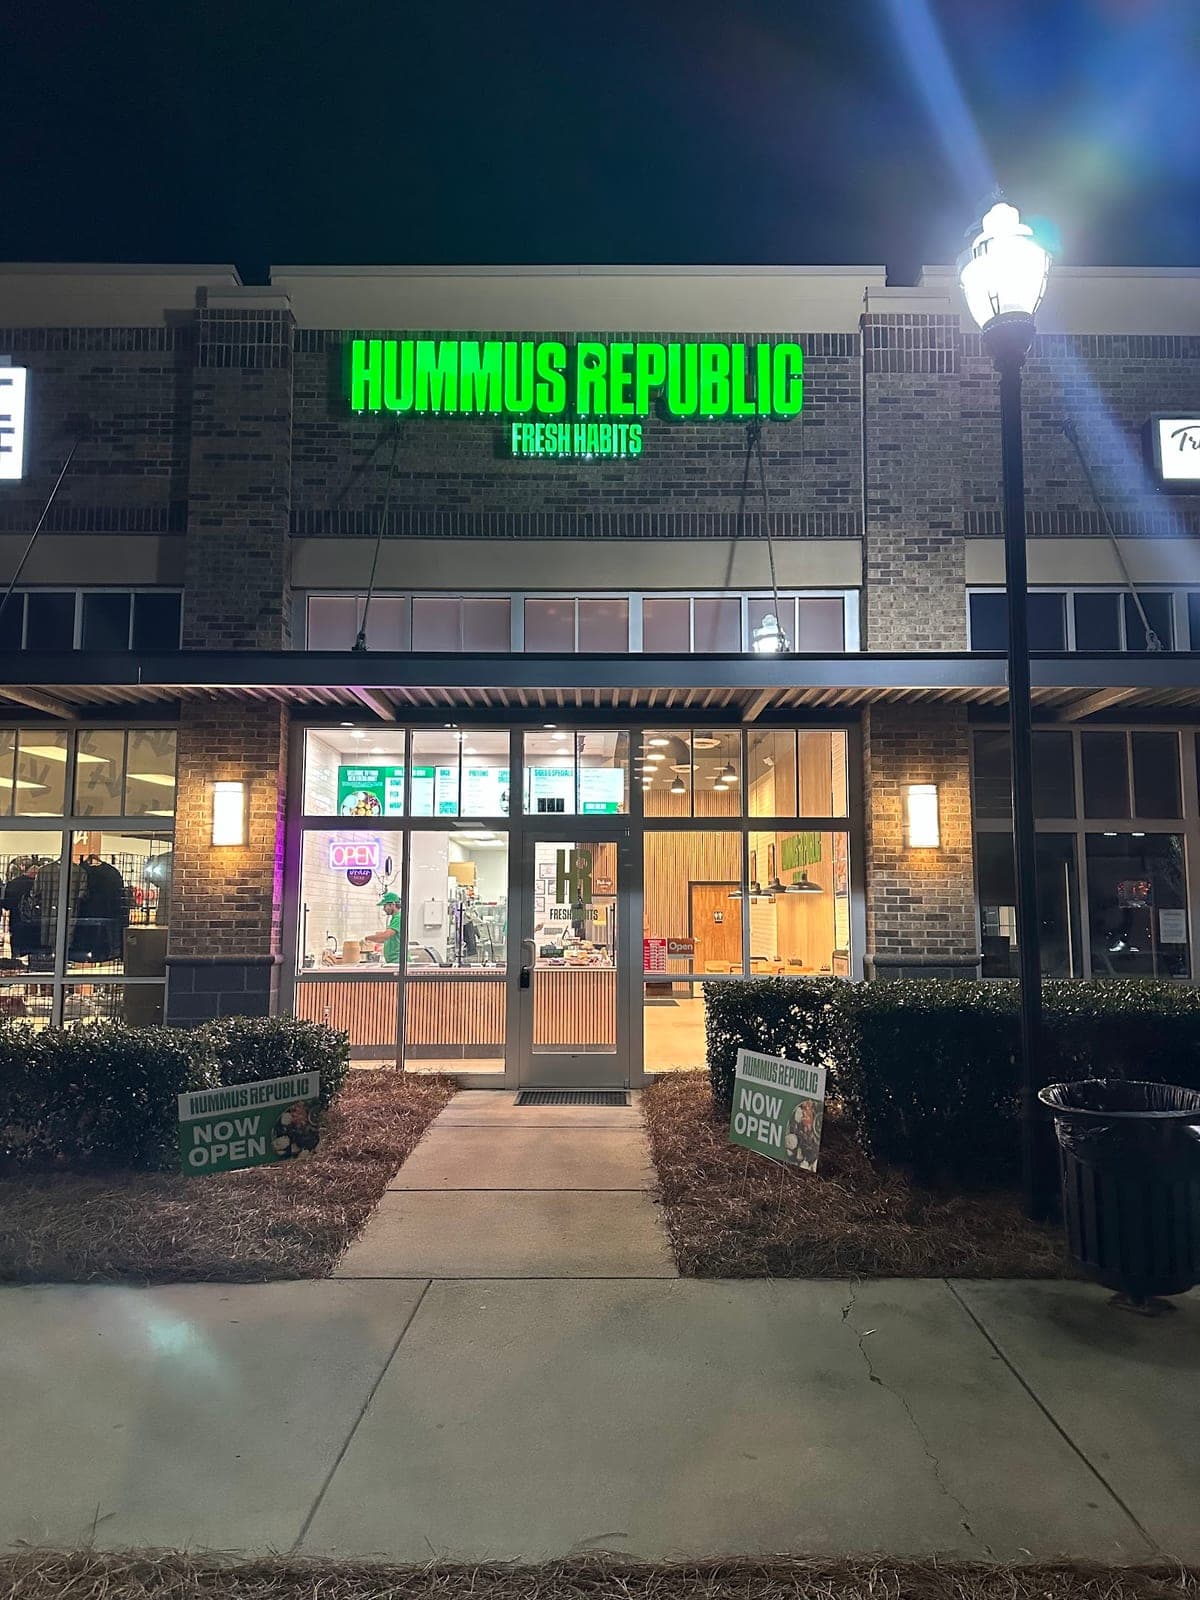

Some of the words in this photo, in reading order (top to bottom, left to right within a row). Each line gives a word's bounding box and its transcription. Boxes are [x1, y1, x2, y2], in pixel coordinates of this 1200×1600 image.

[352, 340, 567, 413] HUMMUS
[577, 343, 803, 415] REPUBLIC
[512, 423, 570, 453] FRESH
[574, 423, 642, 453] HABITS
[1170, 426, 1200, 452] Tr
[332, 846, 377, 866] OPEN
[549, 908, 572, 921] FRESH
[669, 941, 693, 952] Open
[743, 1055, 778, 1083] HUMMUS
[778, 1064, 819, 1094] REPUBLIC
[190, 1088, 248, 1115] HUMMUS
[250, 1078, 309, 1104] REPUBLIC
[740, 1088, 783, 1119] NOW
[193, 1115, 260, 1145] NOW
[734, 1112, 783, 1147] OPEN
[188, 1136, 266, 1167] OPEN
